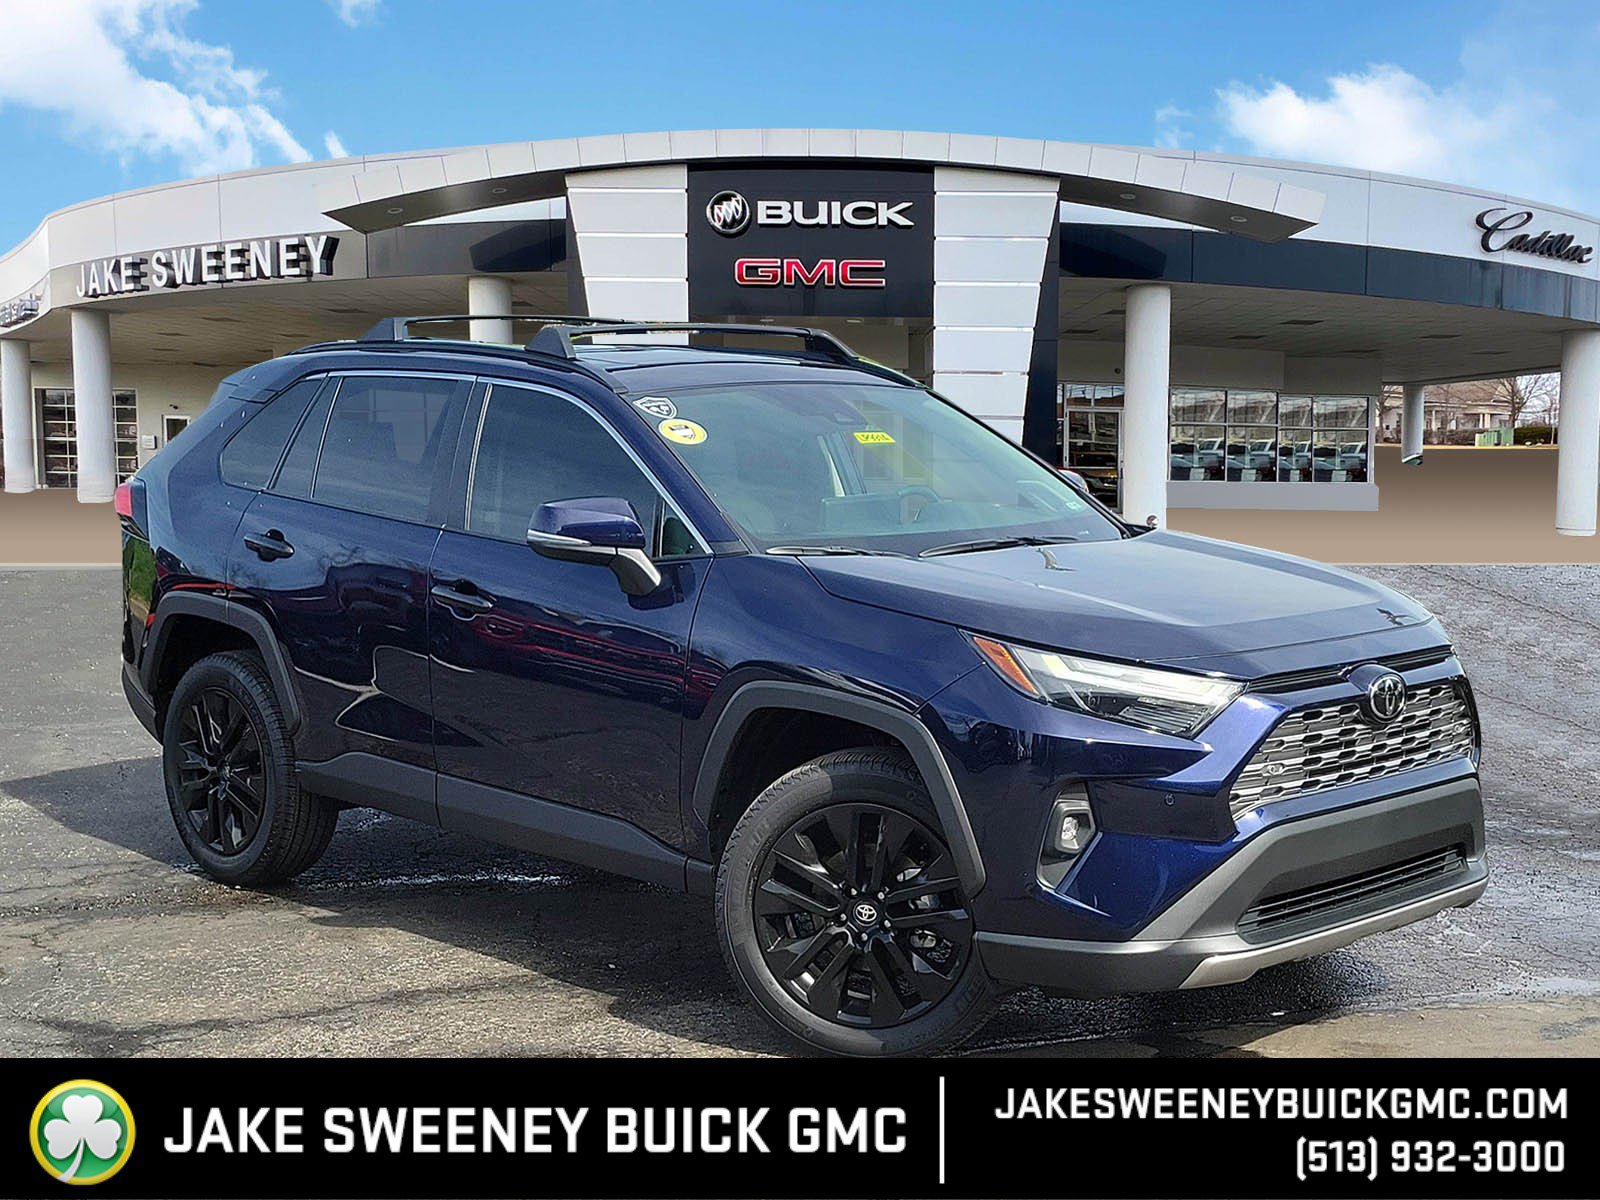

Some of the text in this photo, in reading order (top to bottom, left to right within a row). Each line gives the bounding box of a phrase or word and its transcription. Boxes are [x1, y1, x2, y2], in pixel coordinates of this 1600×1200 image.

[757, 200, 914, 226] BUICK
[1475, 207, 1593, 263] Cadillac
[76, 235, 336, 298] JAKE SWEENEY
[734, 258, 886, 287] GMC
